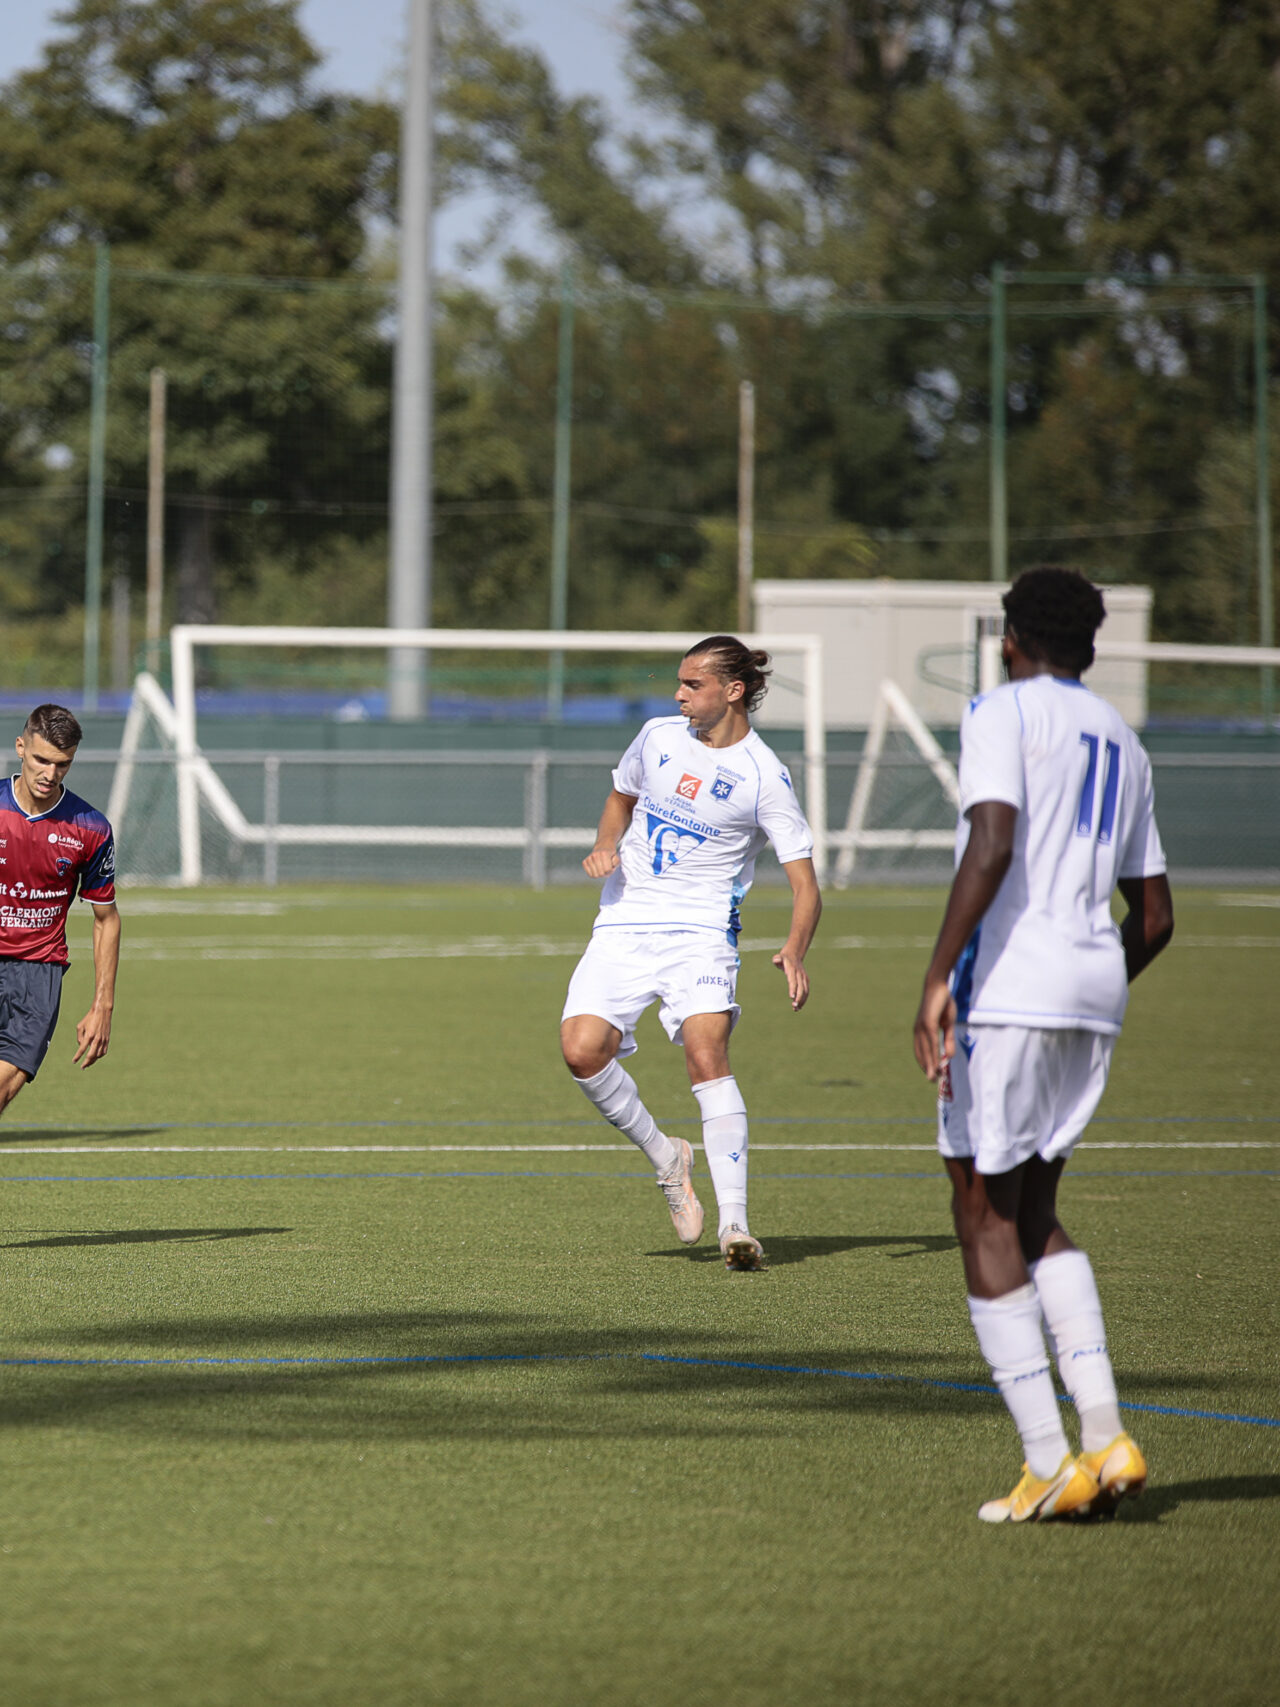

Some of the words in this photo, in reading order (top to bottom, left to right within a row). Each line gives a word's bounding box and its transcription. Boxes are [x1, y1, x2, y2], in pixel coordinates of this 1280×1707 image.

[1076, 730, 1121, 846] 11
[644, 796, 721, 837] Clairefontaine
[0, 905, 63, 918] CLERMONT
[0, 916, 53, 928] FERRAND
